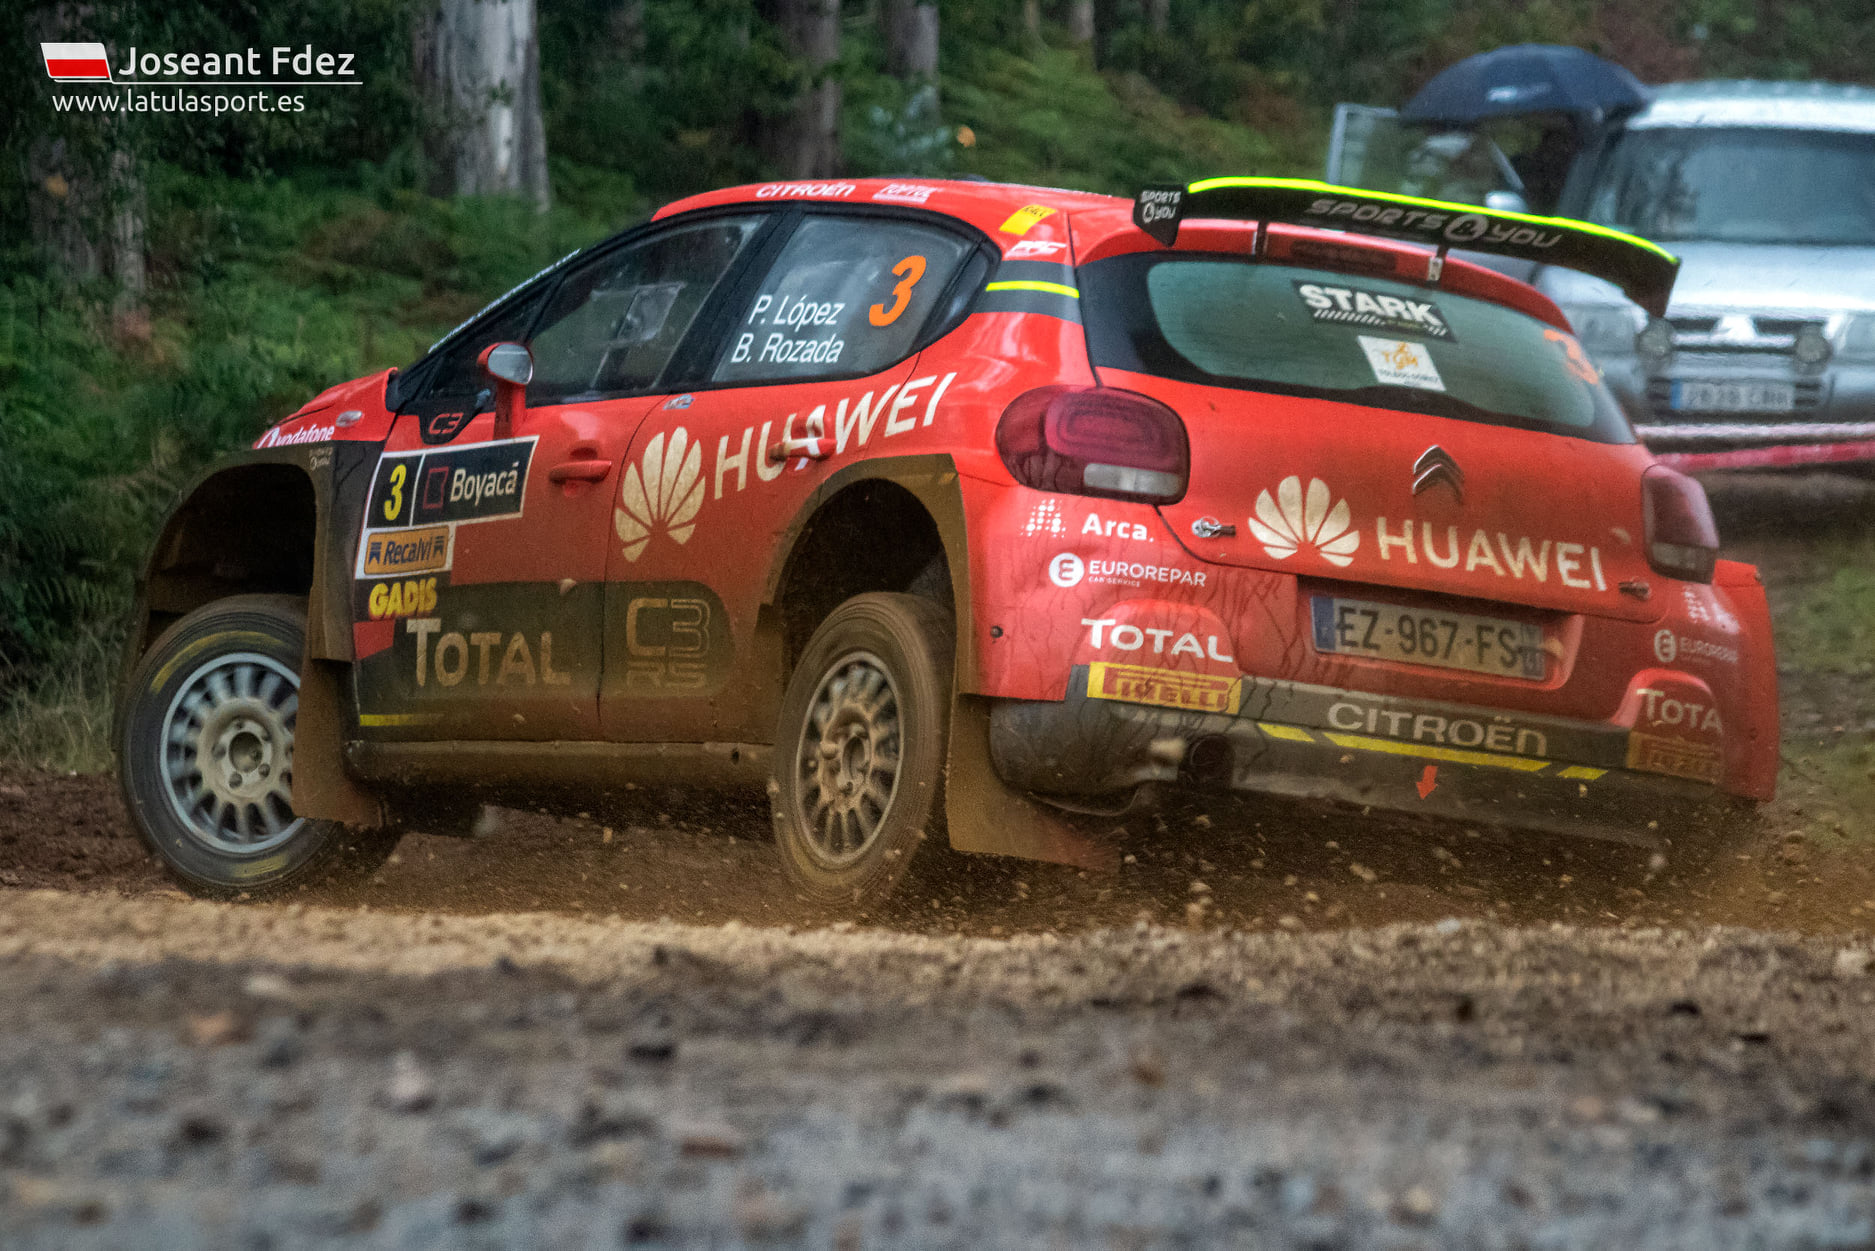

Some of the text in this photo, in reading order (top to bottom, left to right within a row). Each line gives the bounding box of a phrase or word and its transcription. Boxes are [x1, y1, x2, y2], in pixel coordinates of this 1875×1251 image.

[755, 181, 856, 198] CITROËN
[1140, 190, 1181, 204] SPORTS
[868, 254, 927, 327] 3
[1299, 284, 1444, 327] STARK
[748, 294, 846, 333] P. López
[730, 333, 845, 363] B. Rozada
[275, 423, 335, 447] vodafone
[428, 412, 464, 435] C3
[714, 372, 957, 500] HUAWEI
[383, 464, 407, 521] 3
[449, 461, 520, 507] Boyacá
[383, 534, 433, 565] Recalvi
[1081, 513, 1155, 543] Arca.
[1088, 560, 1207, 588] EUROREPAR
[1376, 516, 1608, 592] HUAWEI
[369, 577, 438, 620] GADIS
[626, 597, 711, 657] C3
[1081, 618, 1234, 663] TOTAL
[406, 617, 572, 687] TOTAL
[1327, 702, 1548, 757] CITROËN
